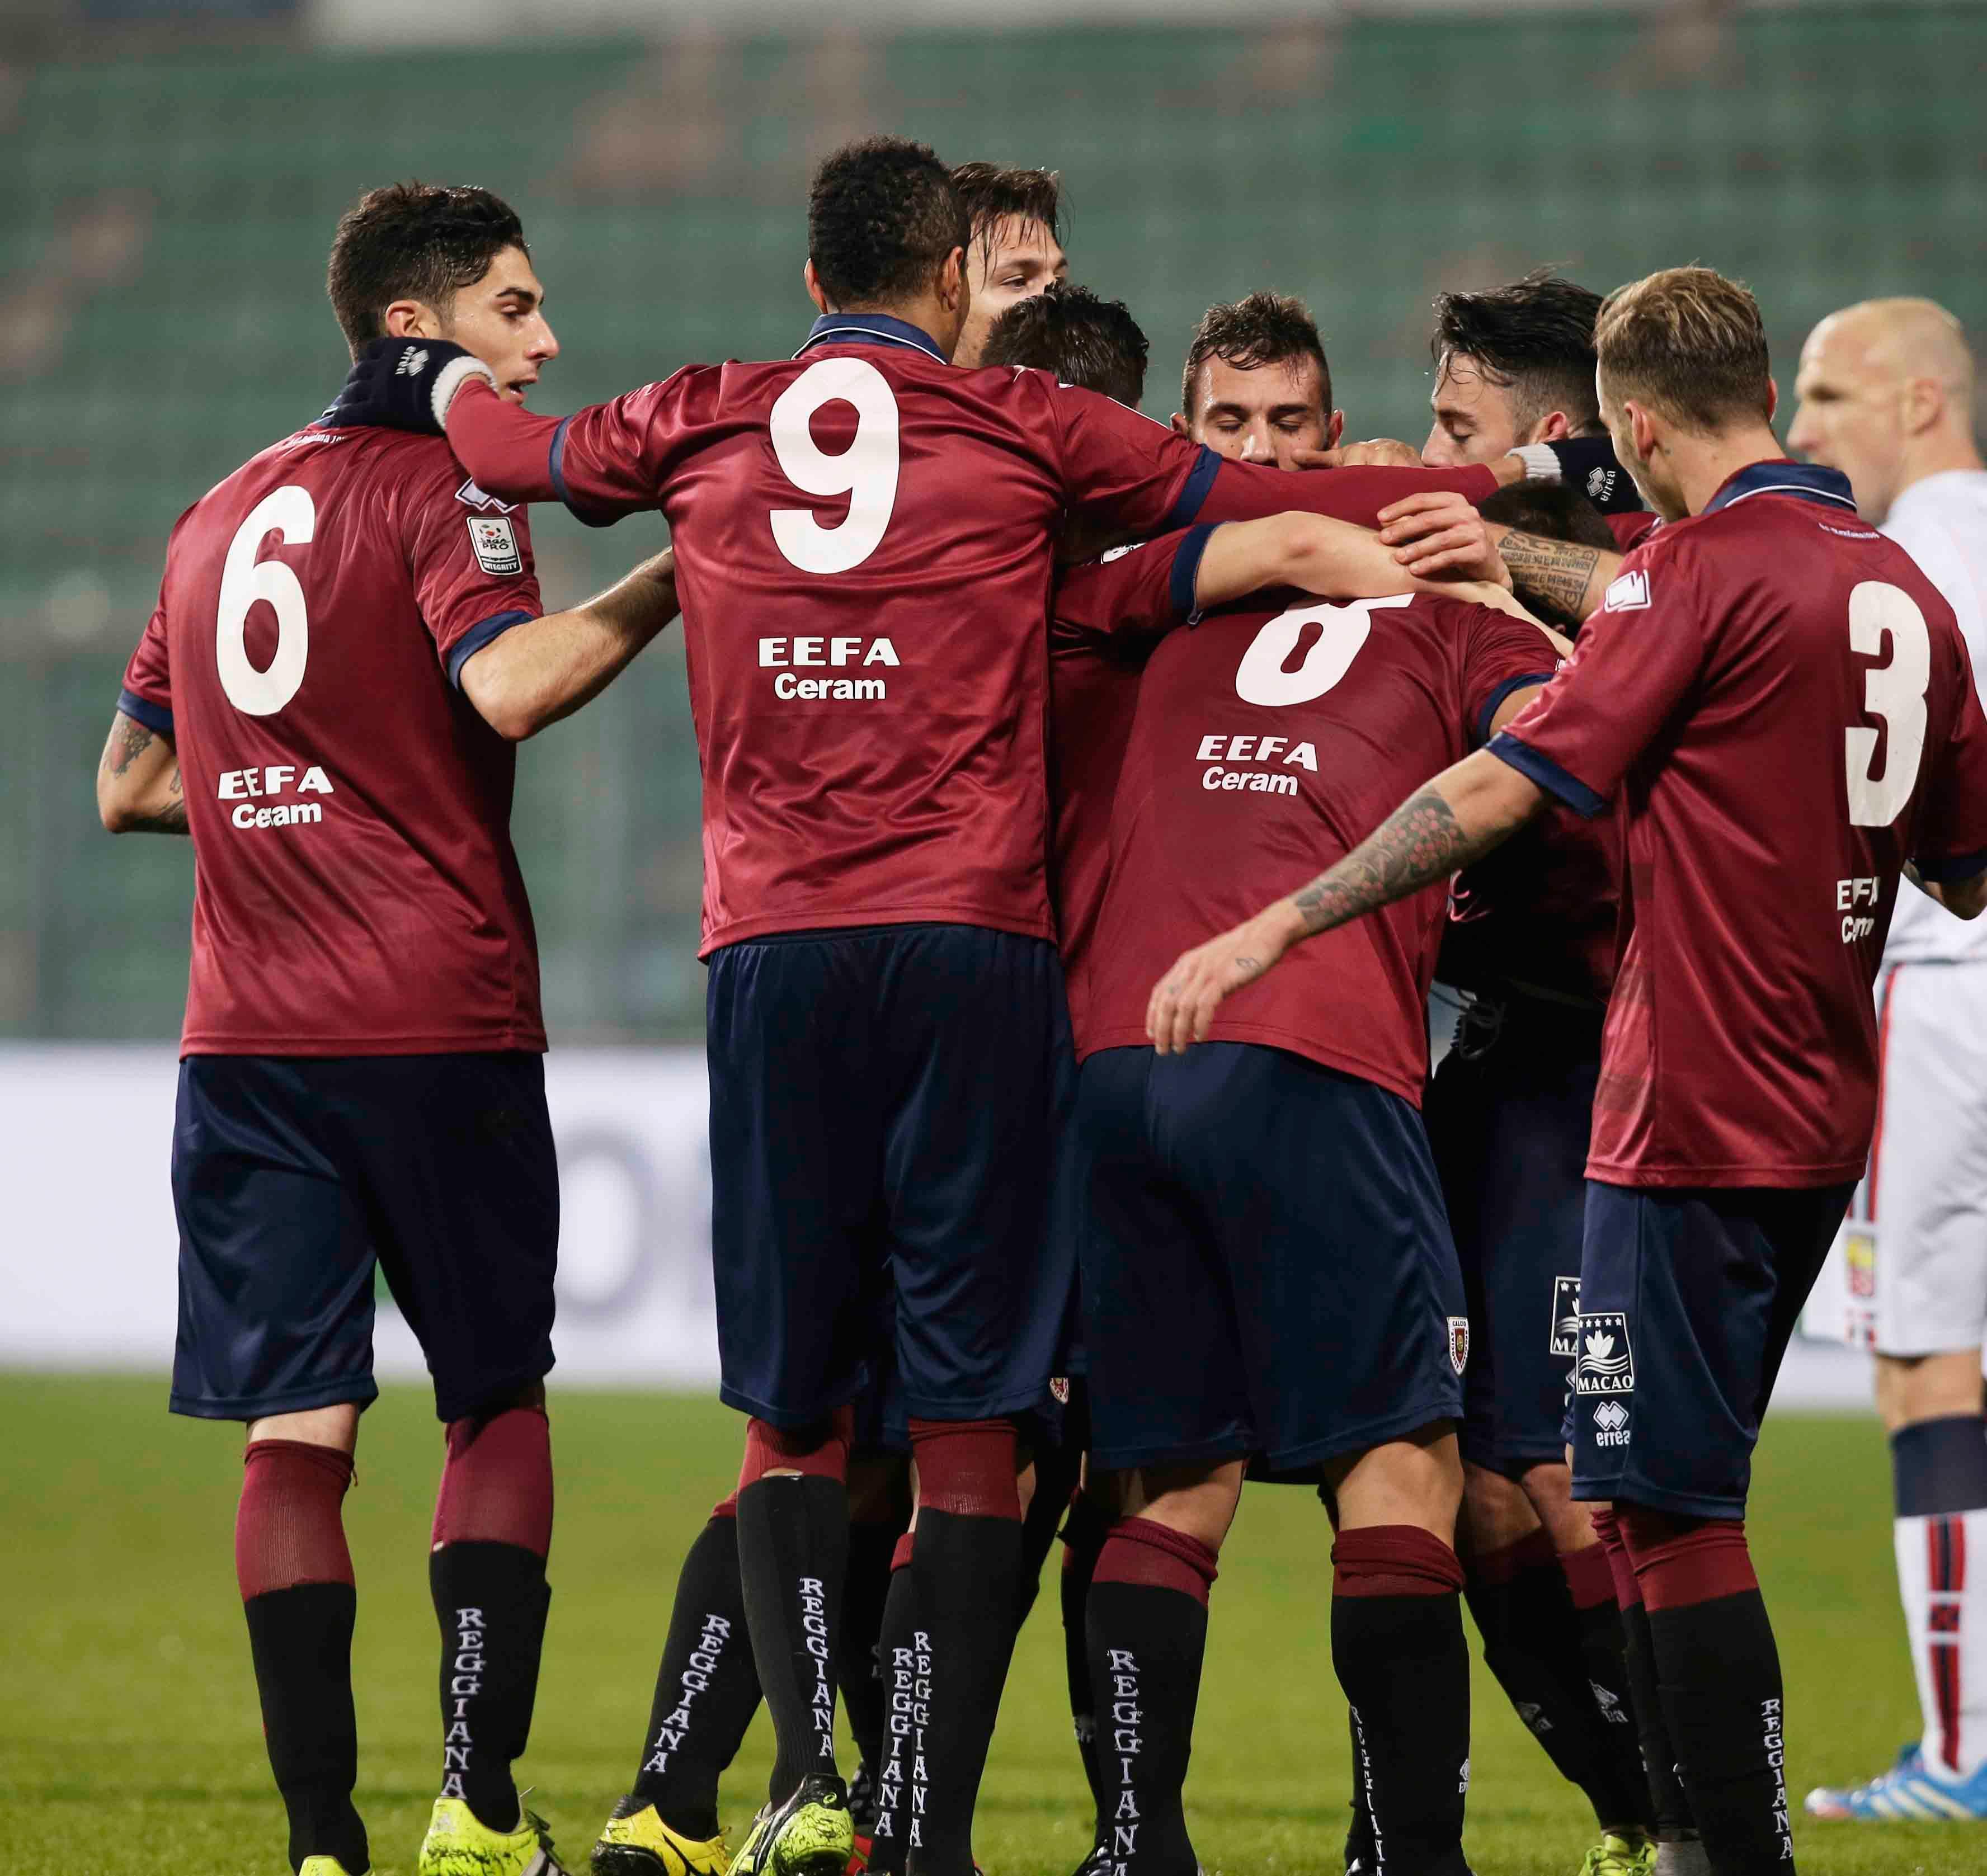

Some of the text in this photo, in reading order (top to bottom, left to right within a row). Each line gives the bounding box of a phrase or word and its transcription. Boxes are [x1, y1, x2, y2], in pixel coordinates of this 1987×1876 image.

[770, 357, 900, 574] 9
[1600, 470, 1616, 502] errea
[216, 485, 316, 716] 6
[759, 637, 900, 667] EEFA
[774, 672, 886, 700] Ceram
[1195, 735, 1319, 772] EEFA
[1845, 581, 1931, 827] 3
[218, 766, 335, 799] EEFA
[1202, 765, 1298, 796] Ceram
[1578, 1375, 1634, 1391] MACAO
[1595, 1430, 1631, 1446] errea
[440, 1608, 487, 1799] REGGIANA
[643, 1614, 731, 1773] REGGIANA
[799, 1577, 833, 1758] REGGIANA
[874, 1647, 915, 1837] REGGIANA
[910, 1631, 933, 1847] REGGIANA
[1761, 1699, 1793, 1860] REGGIANA
